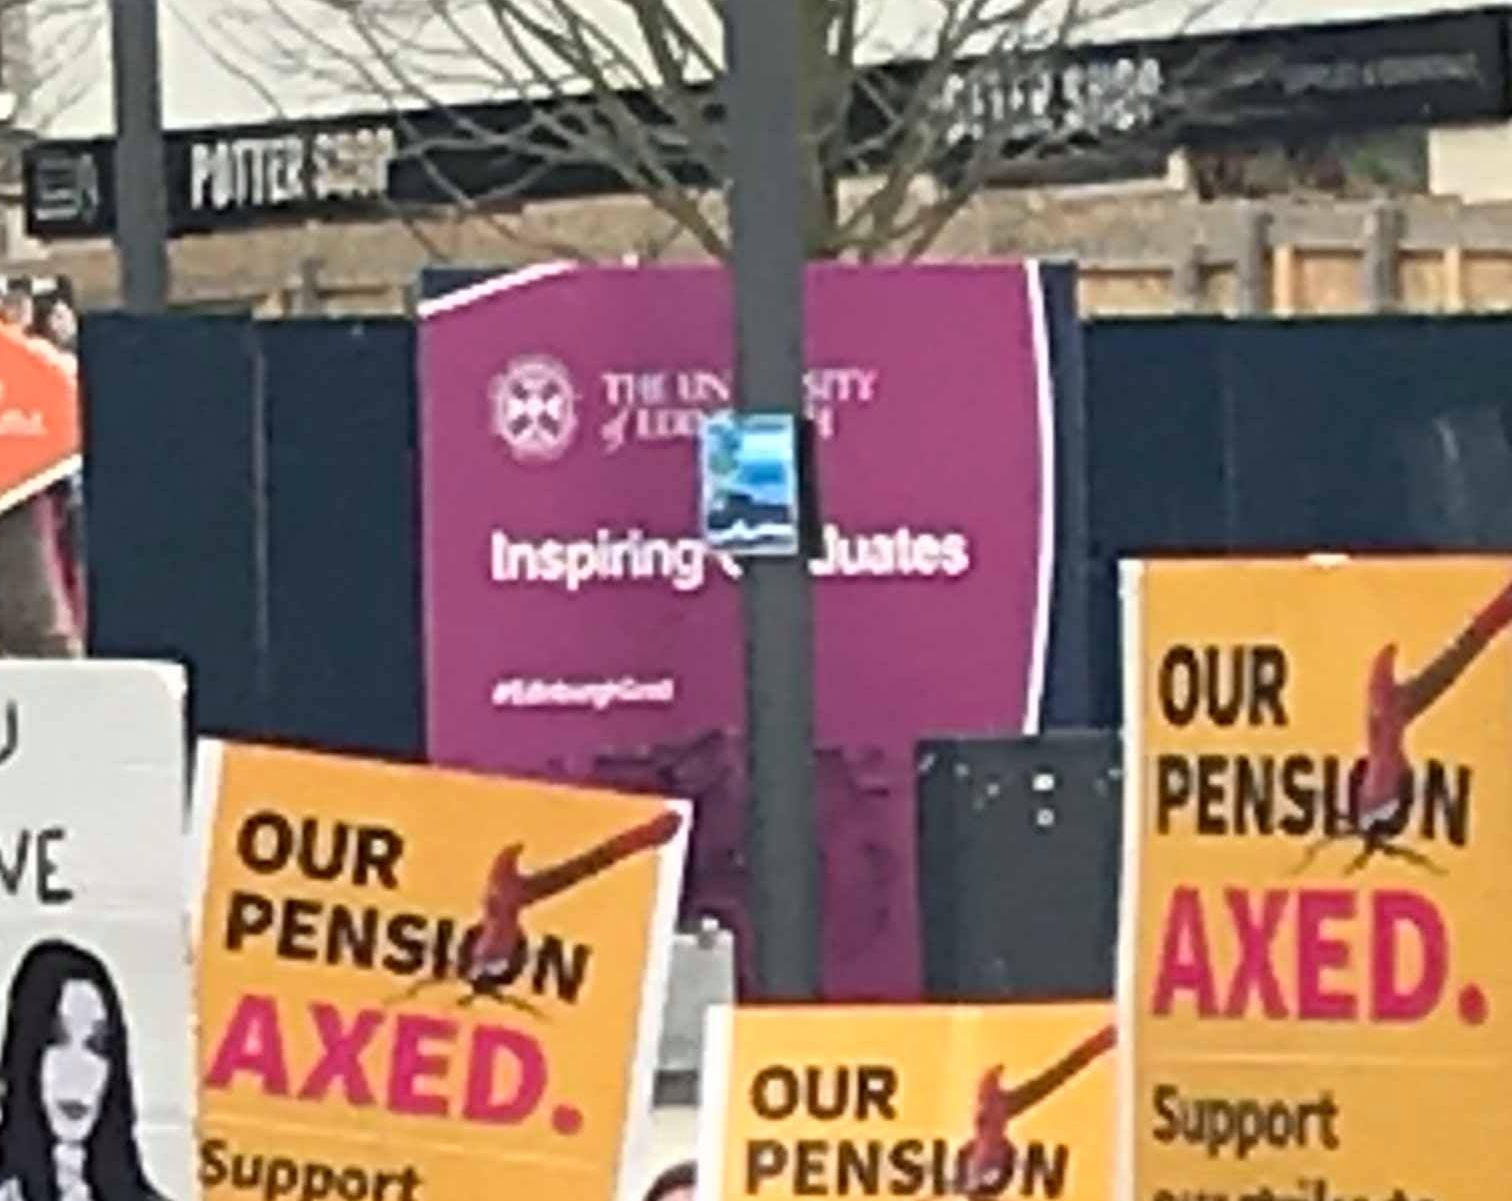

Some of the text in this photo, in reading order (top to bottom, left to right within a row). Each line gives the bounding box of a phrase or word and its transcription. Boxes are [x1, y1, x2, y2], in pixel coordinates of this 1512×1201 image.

[490, 528, 705, 592] Inspiring
[1158, 643, 1289, 728] OUR
[1156, 753, 1472, 848] PENSION
[236, 810, 406, 890] OUR
[224, 892, 594, 1005] PENSION
[1152, 885, 1489, 1025] AXED.
[205, 994, 584, 1137] AXED.
[750, 1064, 899, 1122] OUR
[1152, 1083, 1339, 1159] Support
[744, 1138, 1071, 1201] PENSION
